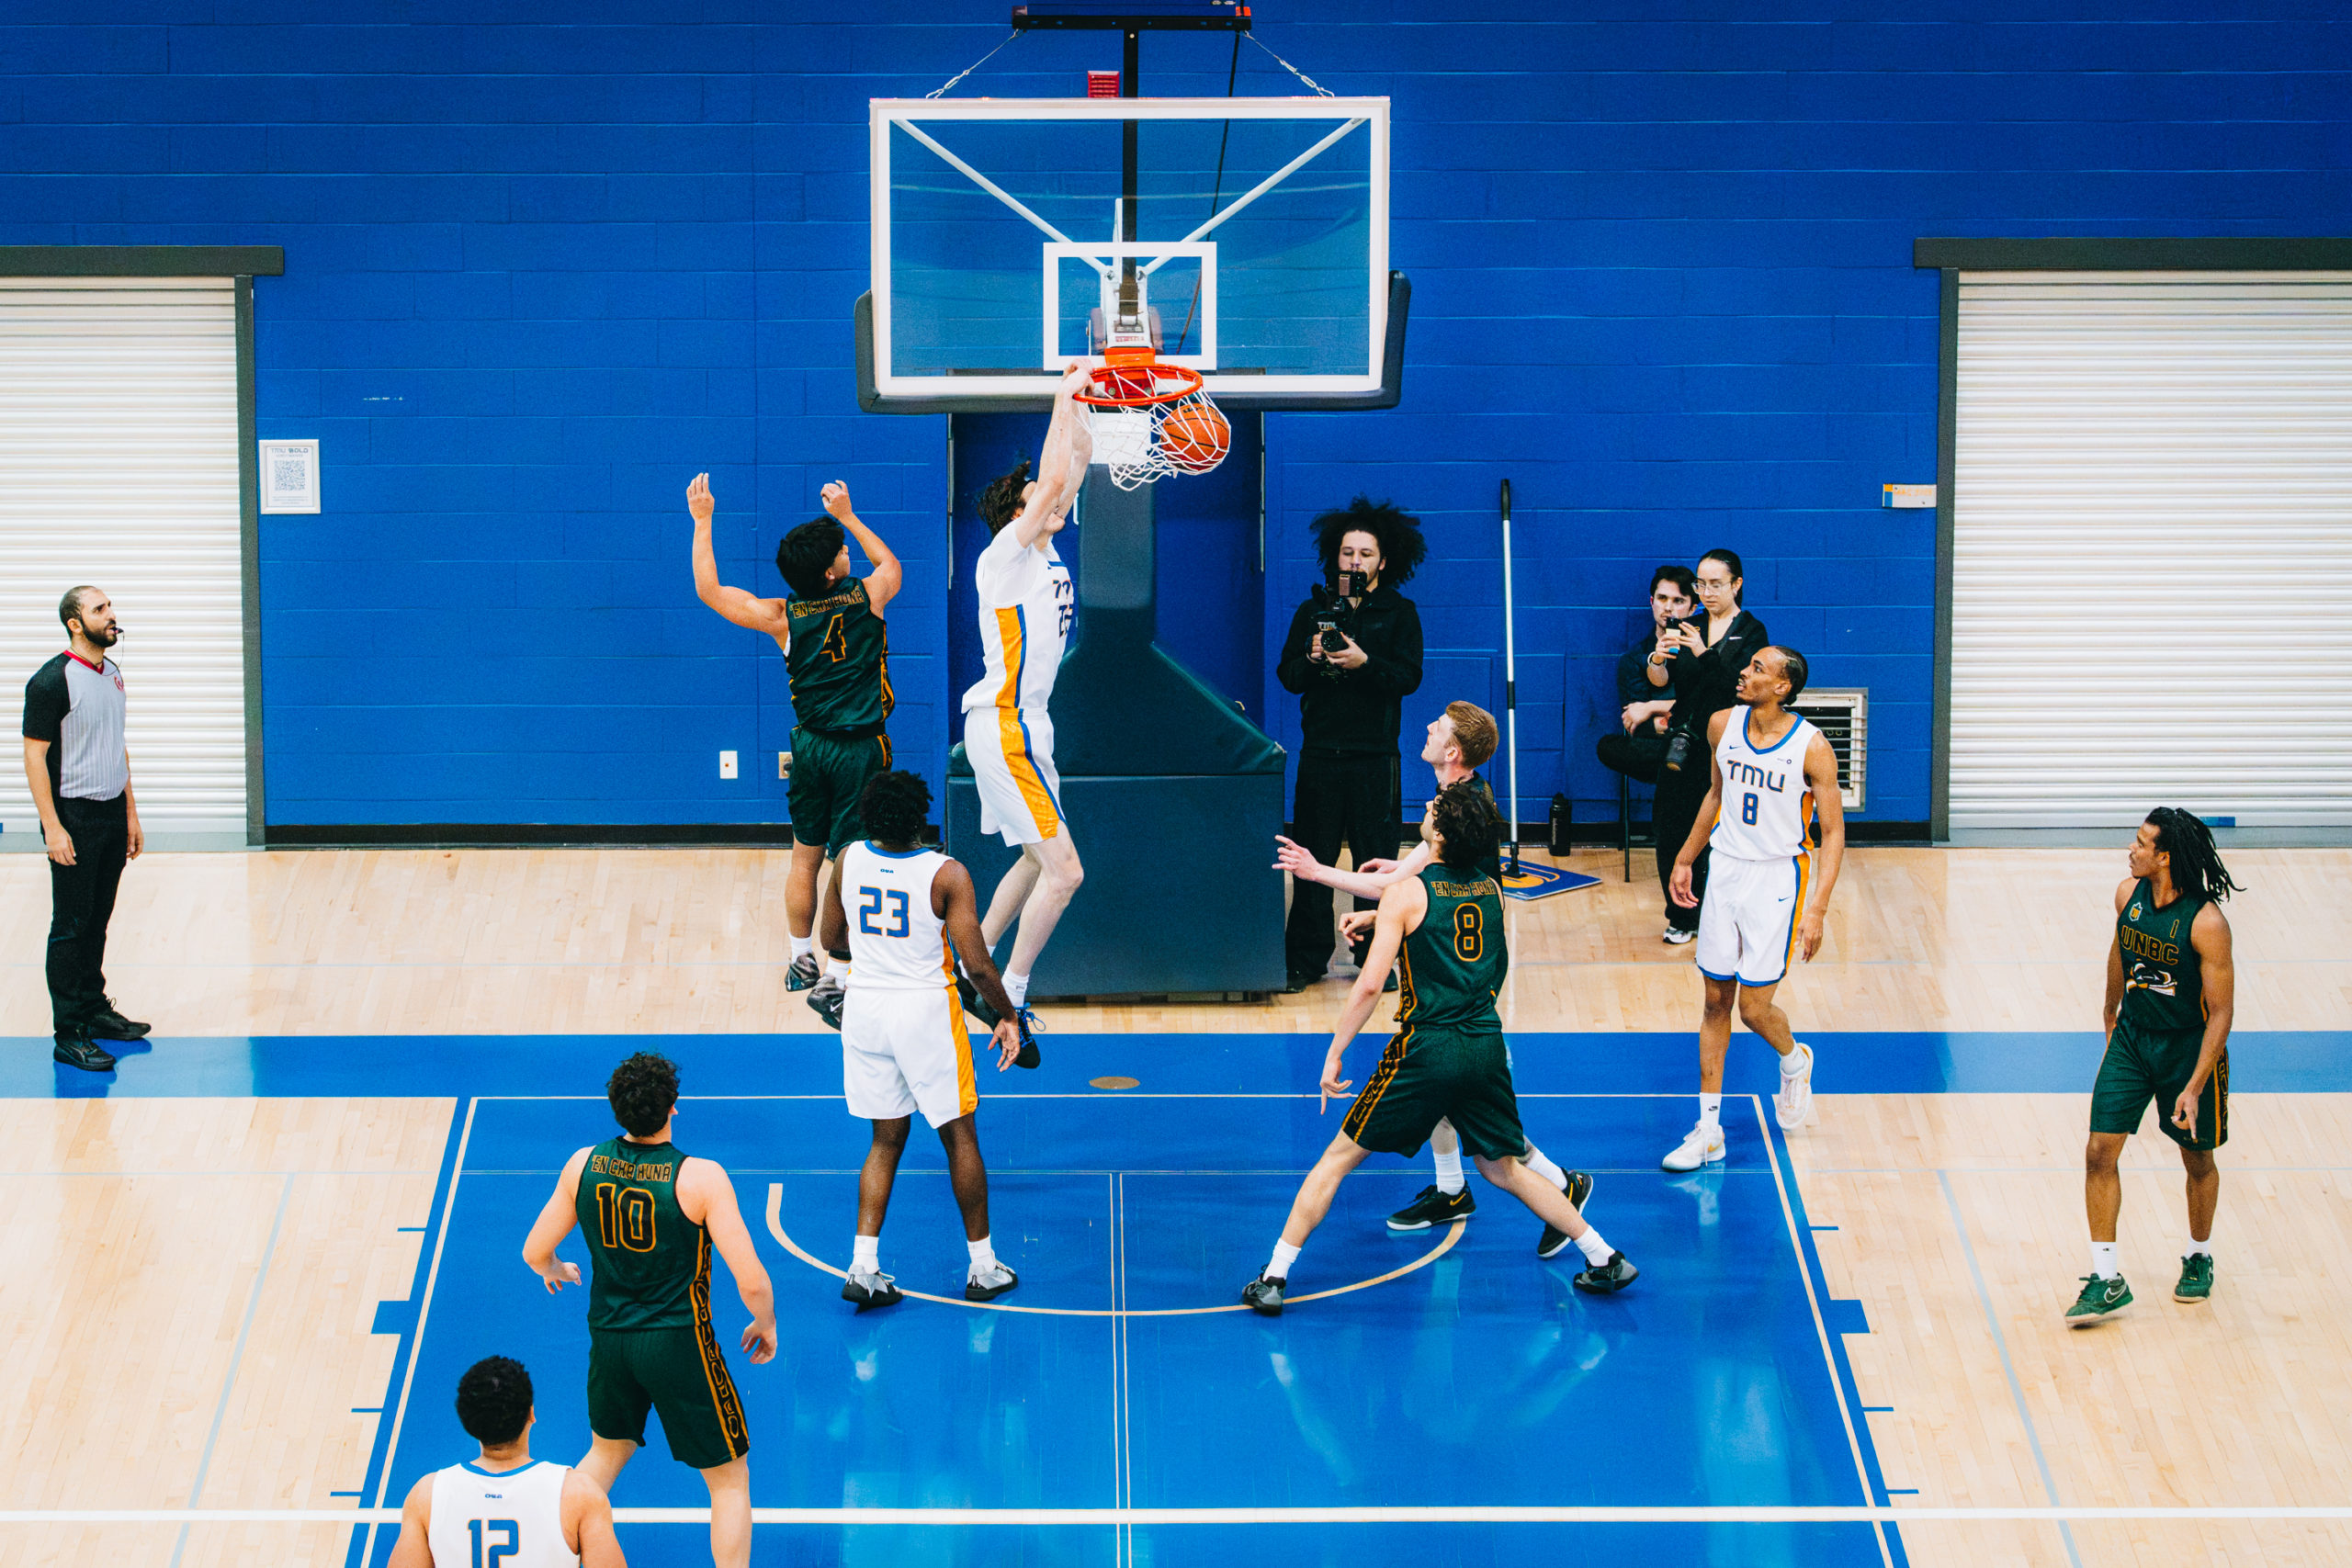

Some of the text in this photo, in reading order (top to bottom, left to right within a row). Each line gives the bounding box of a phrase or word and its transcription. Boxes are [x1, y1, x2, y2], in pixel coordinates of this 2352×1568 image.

[820, 613, 847, 662] 4
[1727, 759, 1786, 793] TMU
[1742, 792, 1759, 827] 8
[859, 885, 910, 939] 23
[1453, 902, 1484, 962] 8
[2169, 919, 2180, 939] 1
[2120, 924, 2180, 965] UNBC
[596, 1182, 657, 1253] 10
[467, 1517, 521, 1568] 12
